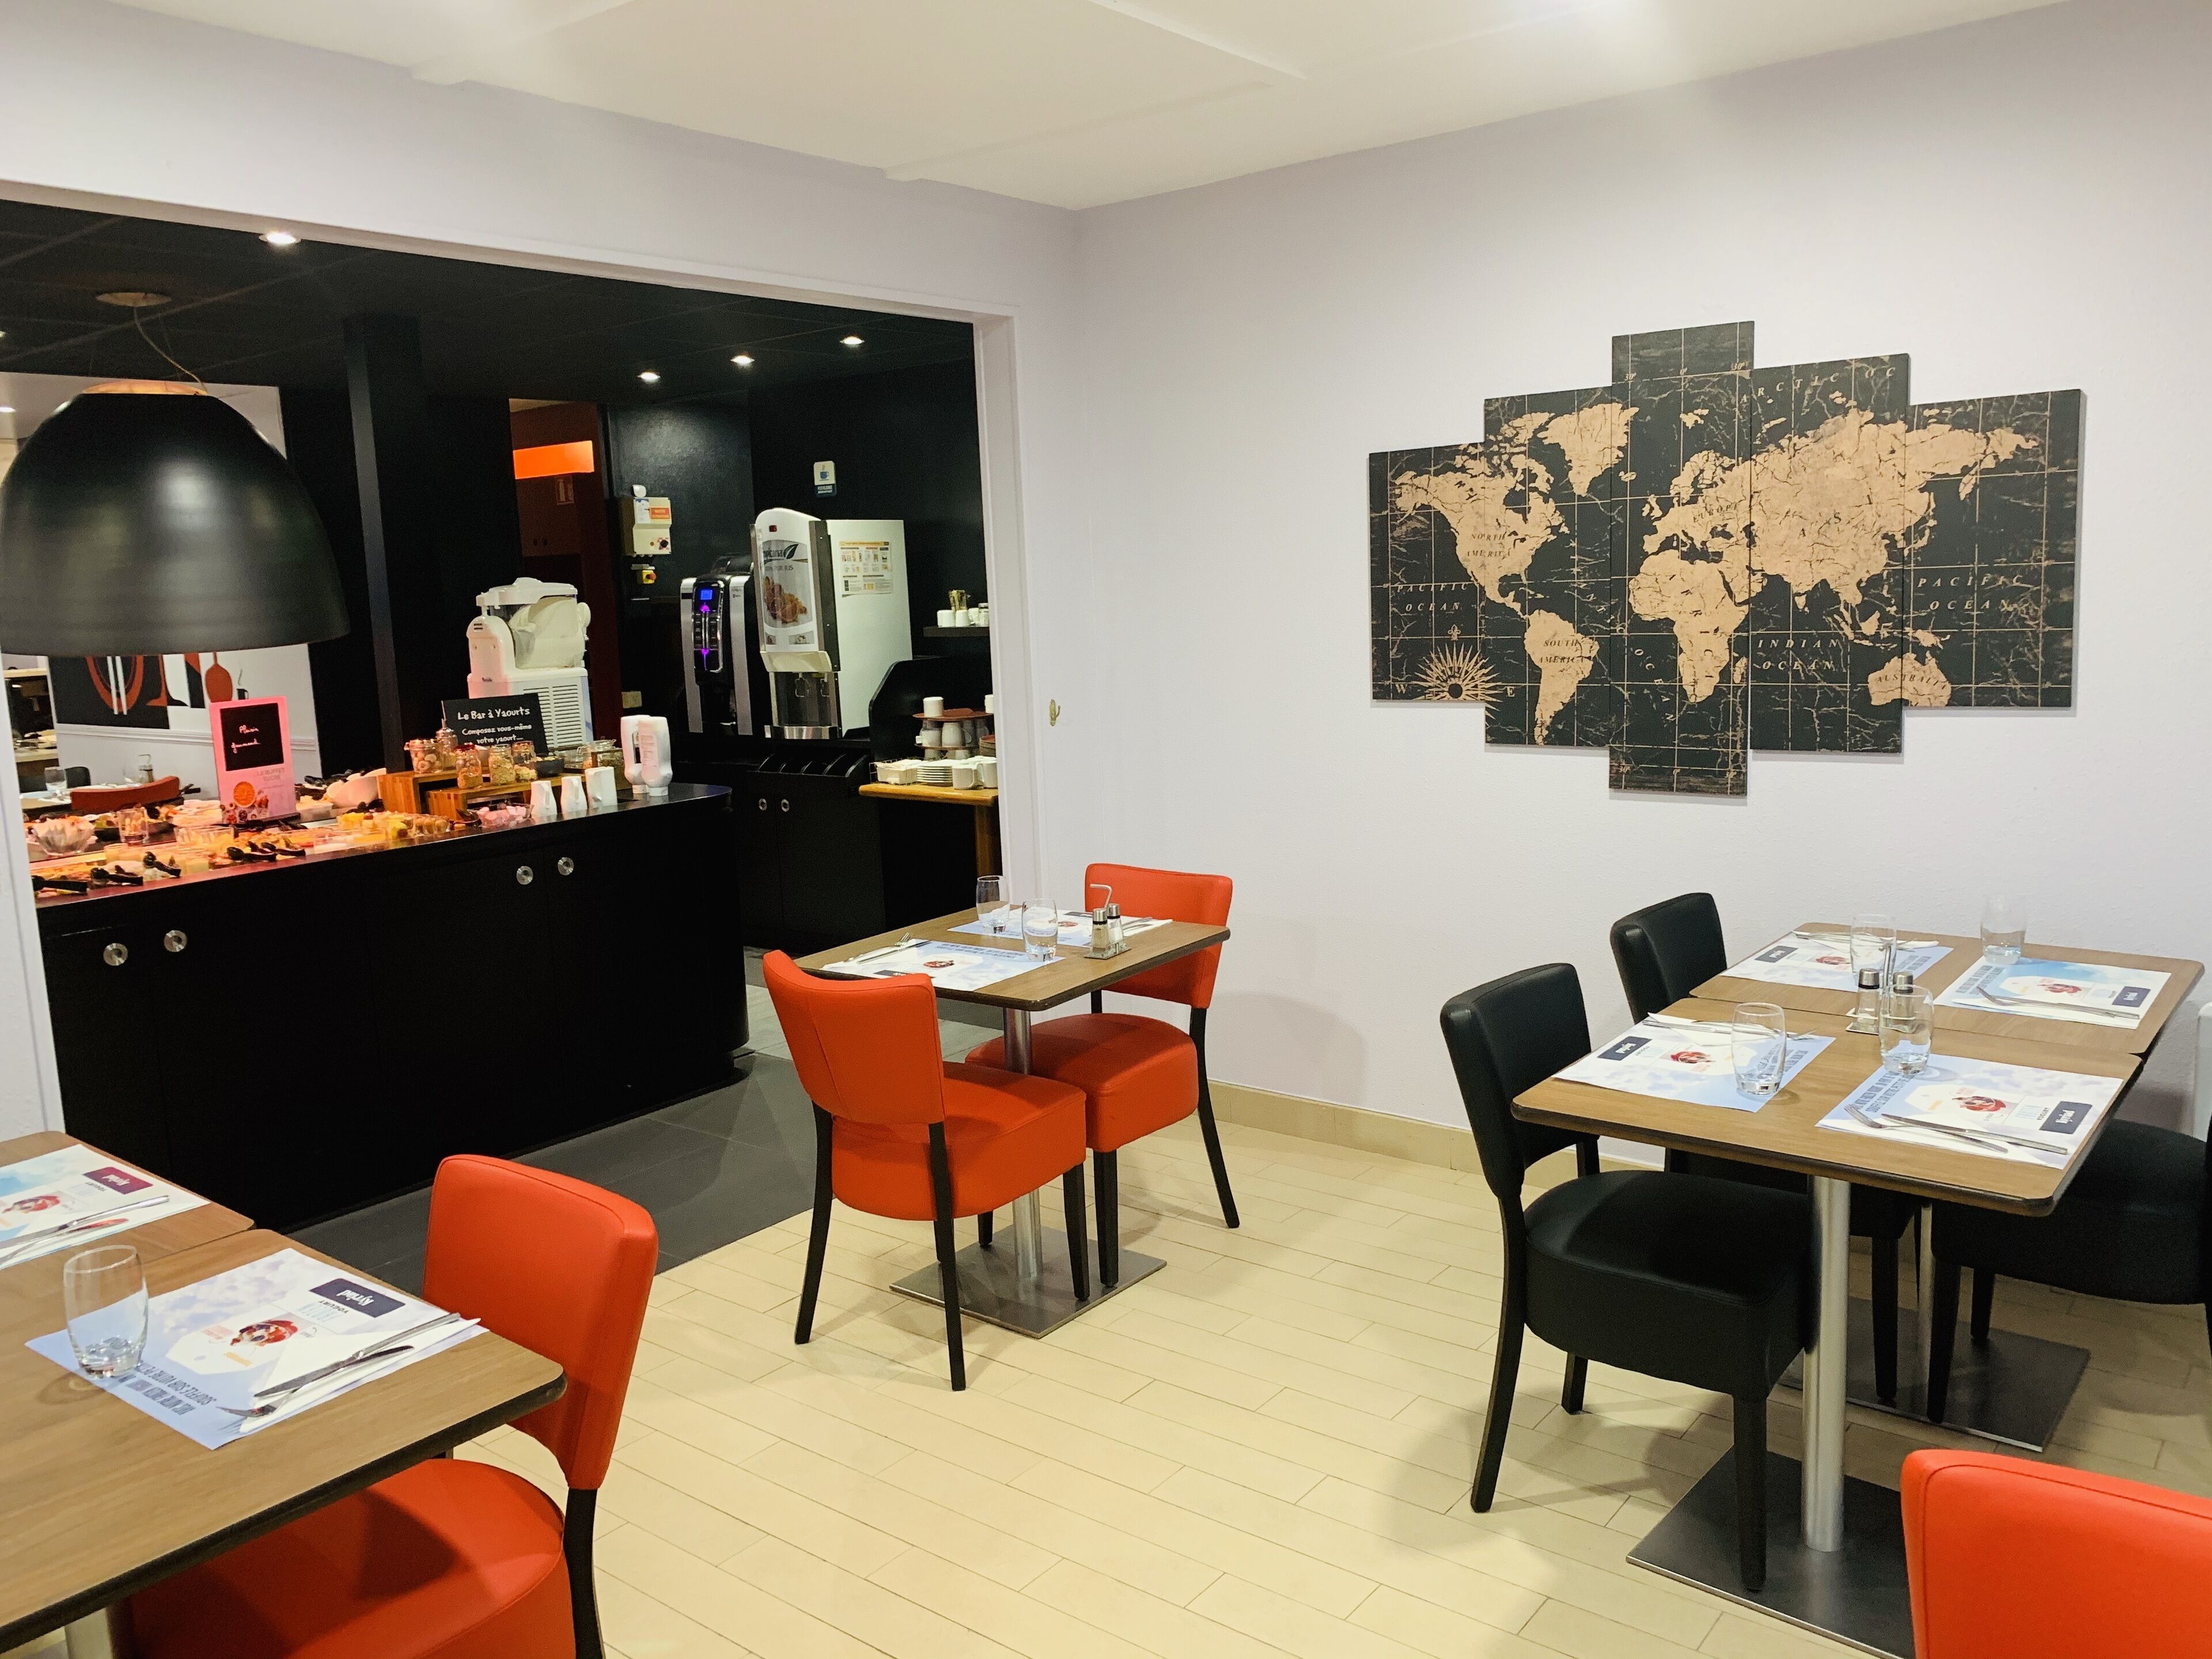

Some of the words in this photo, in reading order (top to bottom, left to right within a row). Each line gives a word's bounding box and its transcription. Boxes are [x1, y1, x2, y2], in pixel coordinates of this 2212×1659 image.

[1918, 574, 2023, 588] PACIFIC
[1397, 583, 1469, 593] PACIFIC
[1406, 602, 1460, 611] OCEAN
[1930, 600, 2010, 612] OCEAN
[1544, 639, 1579, 647] SOUTH
[1758, 639, 1839, 648] INDIAN
[1538, 656, 1584, 664] AMERICA
[1762, 660, 1834, 670] OCEAN
[457, 711, 469, 720] Le
[470, 710, 486, 719] Bar
[488, 709, 493, 718] à
[495, 706, 531, 717] Yaourts
[462, 728, 496, 736] Composez
[497, 723, 532, 732] vous-même
[476, 736, 494, 744] votre
[336, 1289, 375, 1306] Kyriad
[318, 1300, 349, 1314] YOGURT
